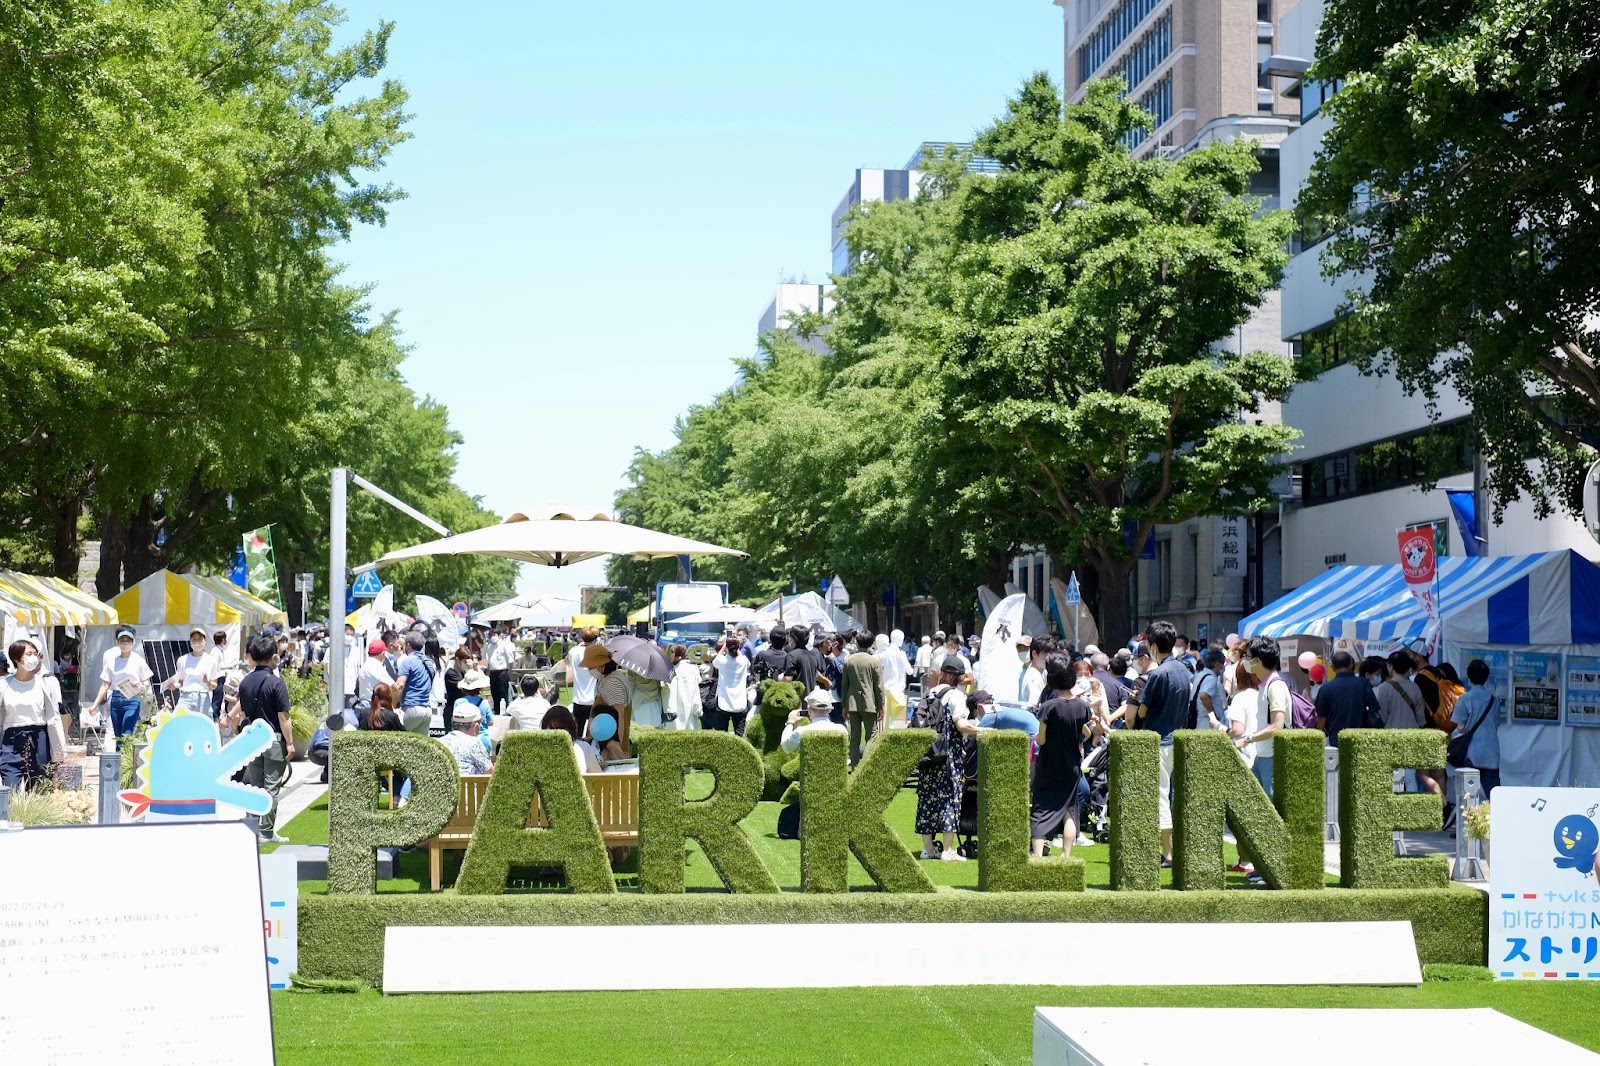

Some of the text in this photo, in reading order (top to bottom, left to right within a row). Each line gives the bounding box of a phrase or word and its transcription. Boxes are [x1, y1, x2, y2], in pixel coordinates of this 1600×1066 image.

[328, 728, 1451, 894] PARK LINE
[1544, 890, 1586, 903] tvk
[1502, 936, 1598, 964] ストリ
